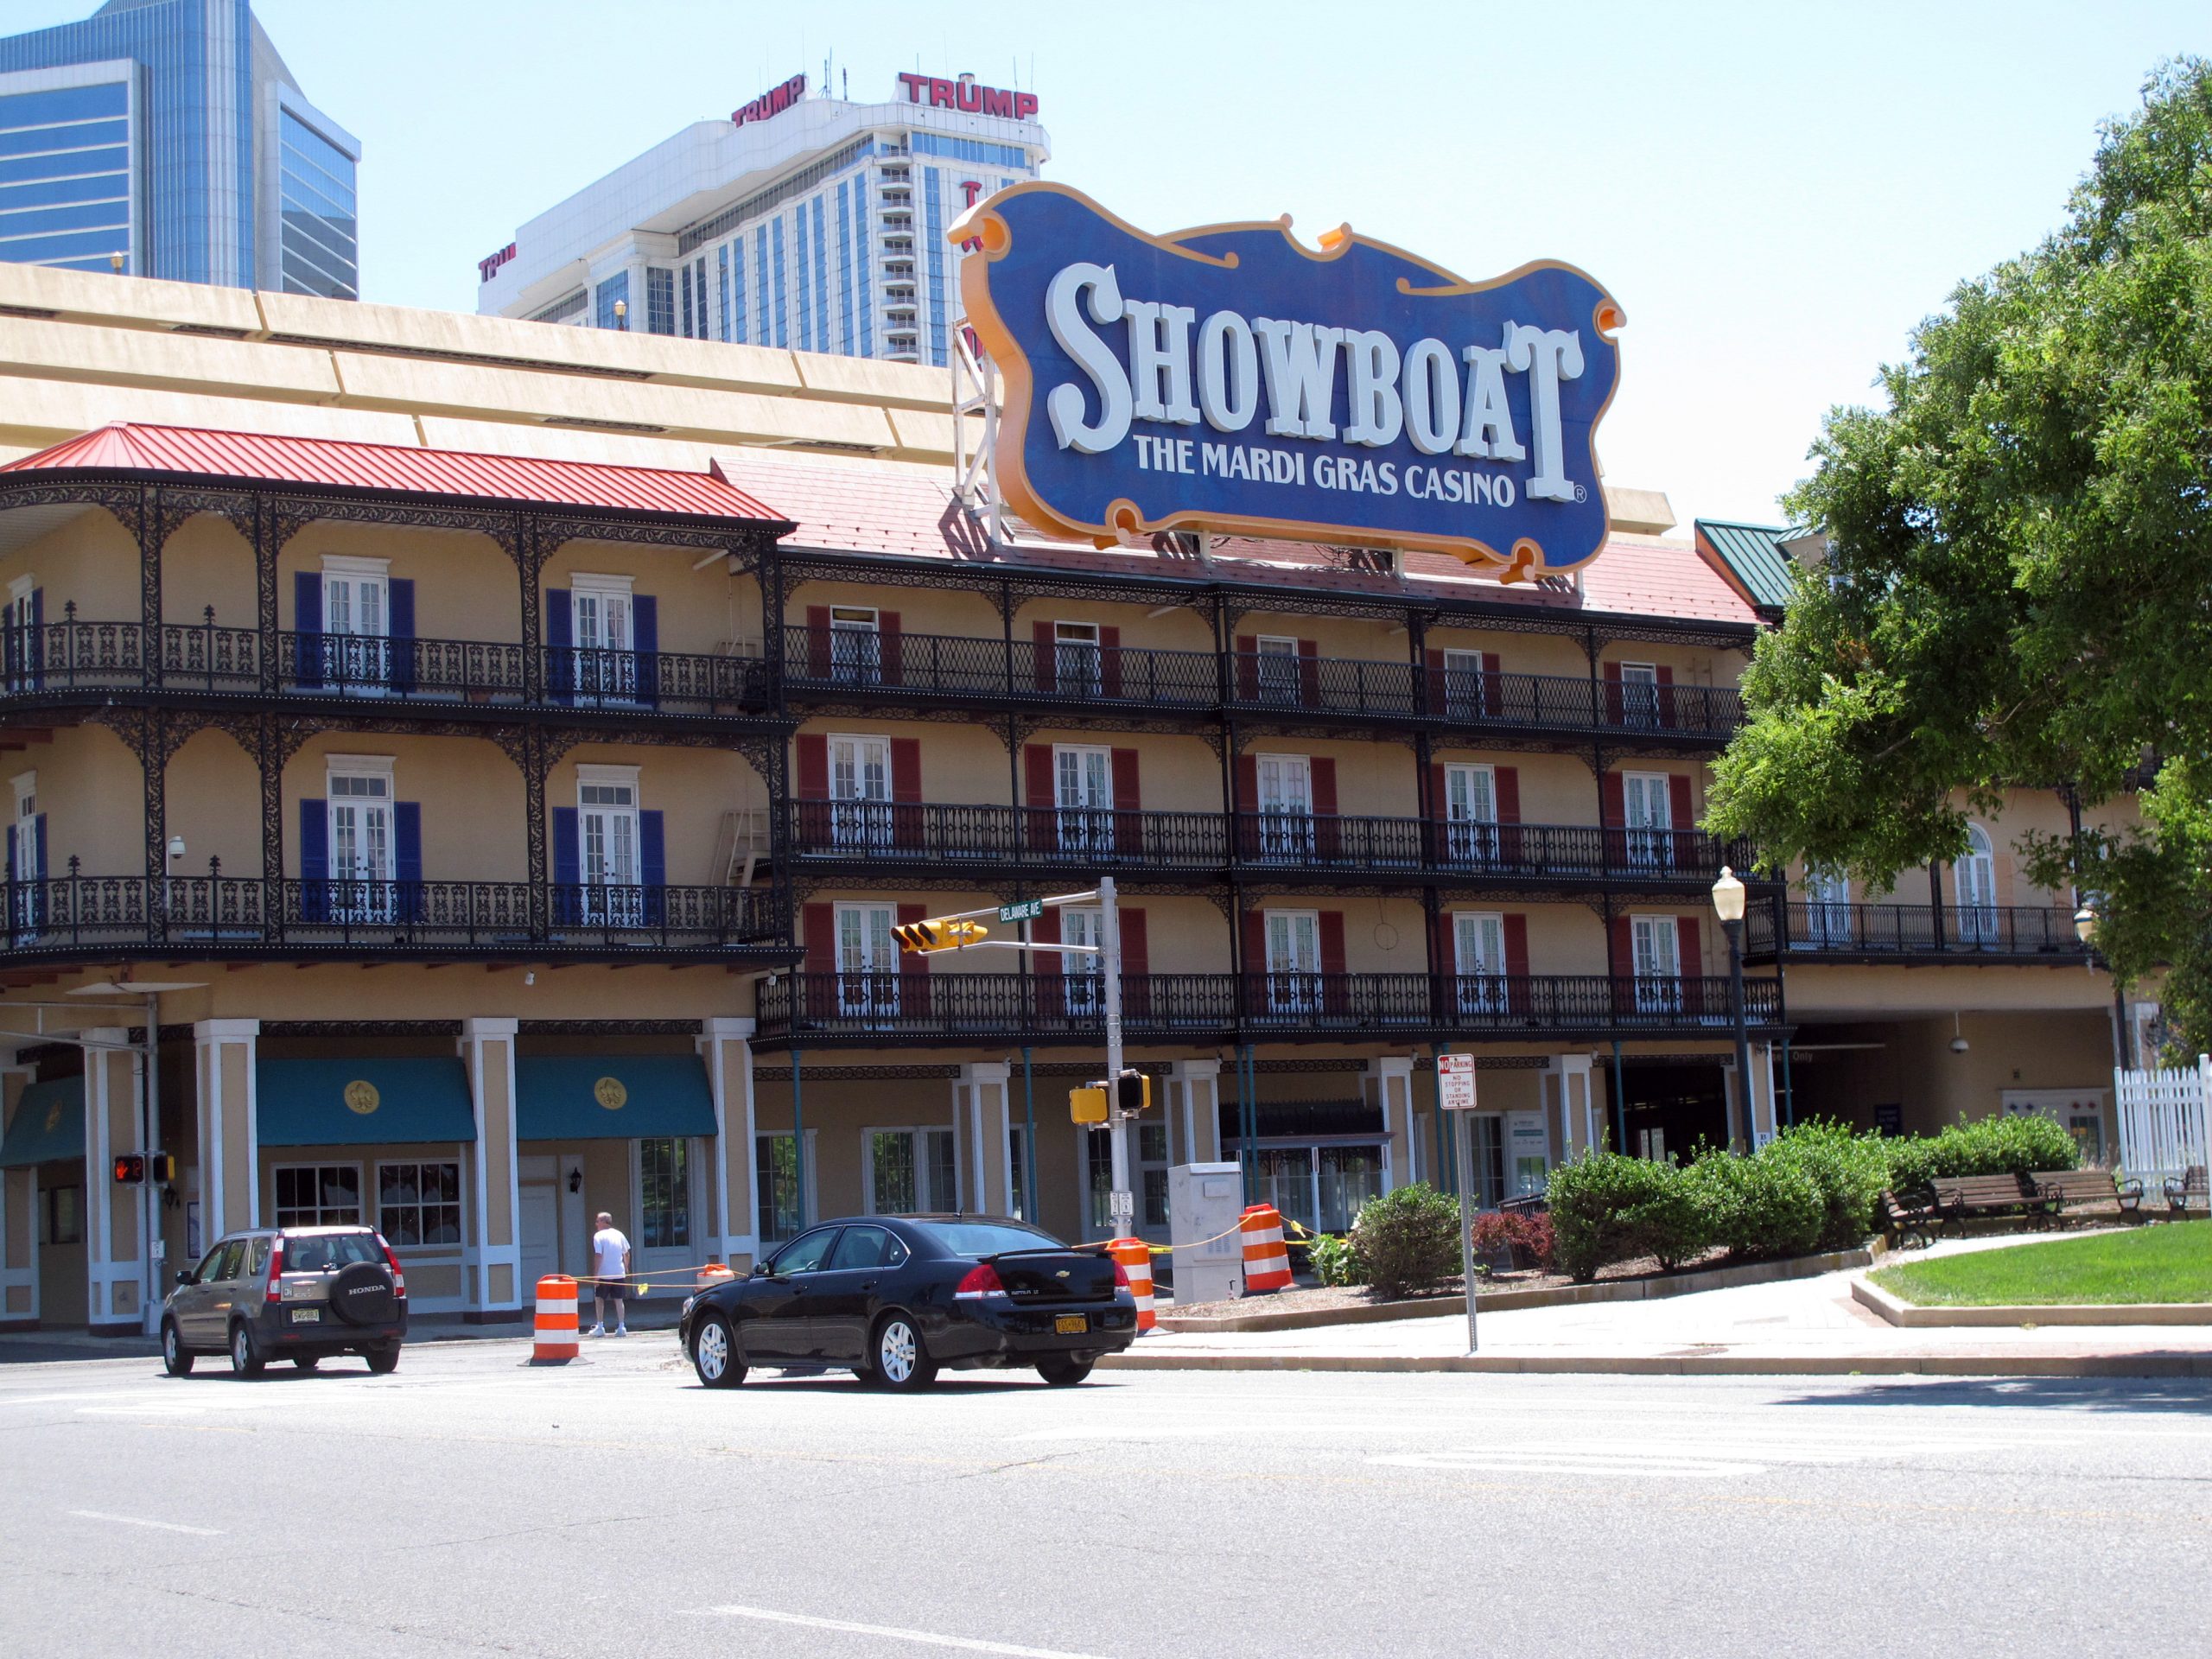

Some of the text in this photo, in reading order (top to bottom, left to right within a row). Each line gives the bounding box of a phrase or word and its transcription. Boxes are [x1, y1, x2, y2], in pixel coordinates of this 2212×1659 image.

[731, 73, 805, 128] TRUMP
[899, 72, 1039, 120] TRUMP
[1046, 262, 1585, 503] SHOWBOAT
[1133, 435, 1196, 474] THE
[1202, 442, 1306, 486] MARDI
[1313, 455, 1399, 496] GRAS
[1405, 466, 1516, 508] CASINO
[1000, 901, 1040, 921] DELAWARE AVE
[1793, 1051, 1814, 1063] Only
[348, 1284, 387, 1295] HONDA
